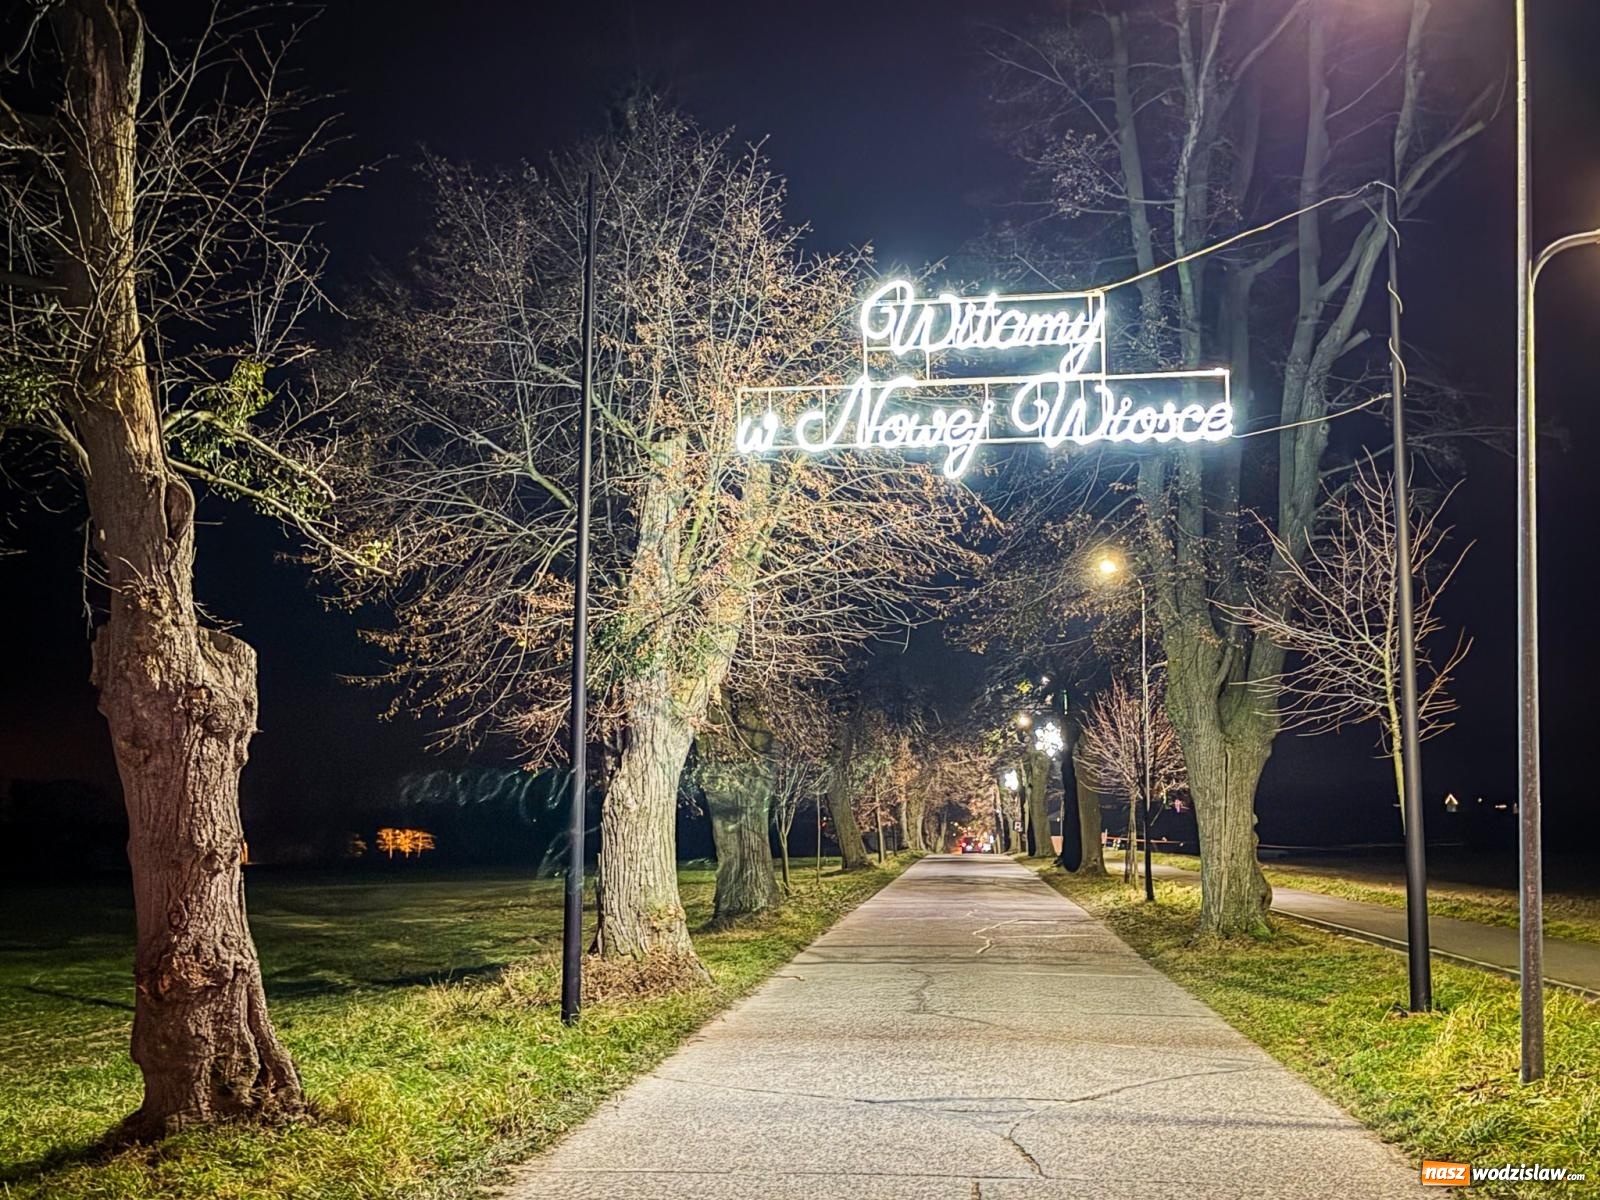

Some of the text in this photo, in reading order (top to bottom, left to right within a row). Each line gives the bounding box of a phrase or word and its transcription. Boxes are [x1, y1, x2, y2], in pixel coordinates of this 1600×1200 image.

[860, 280, 1105, 374] Witamy
[737, 373, 1233, 479] w Nowej Wiosce
